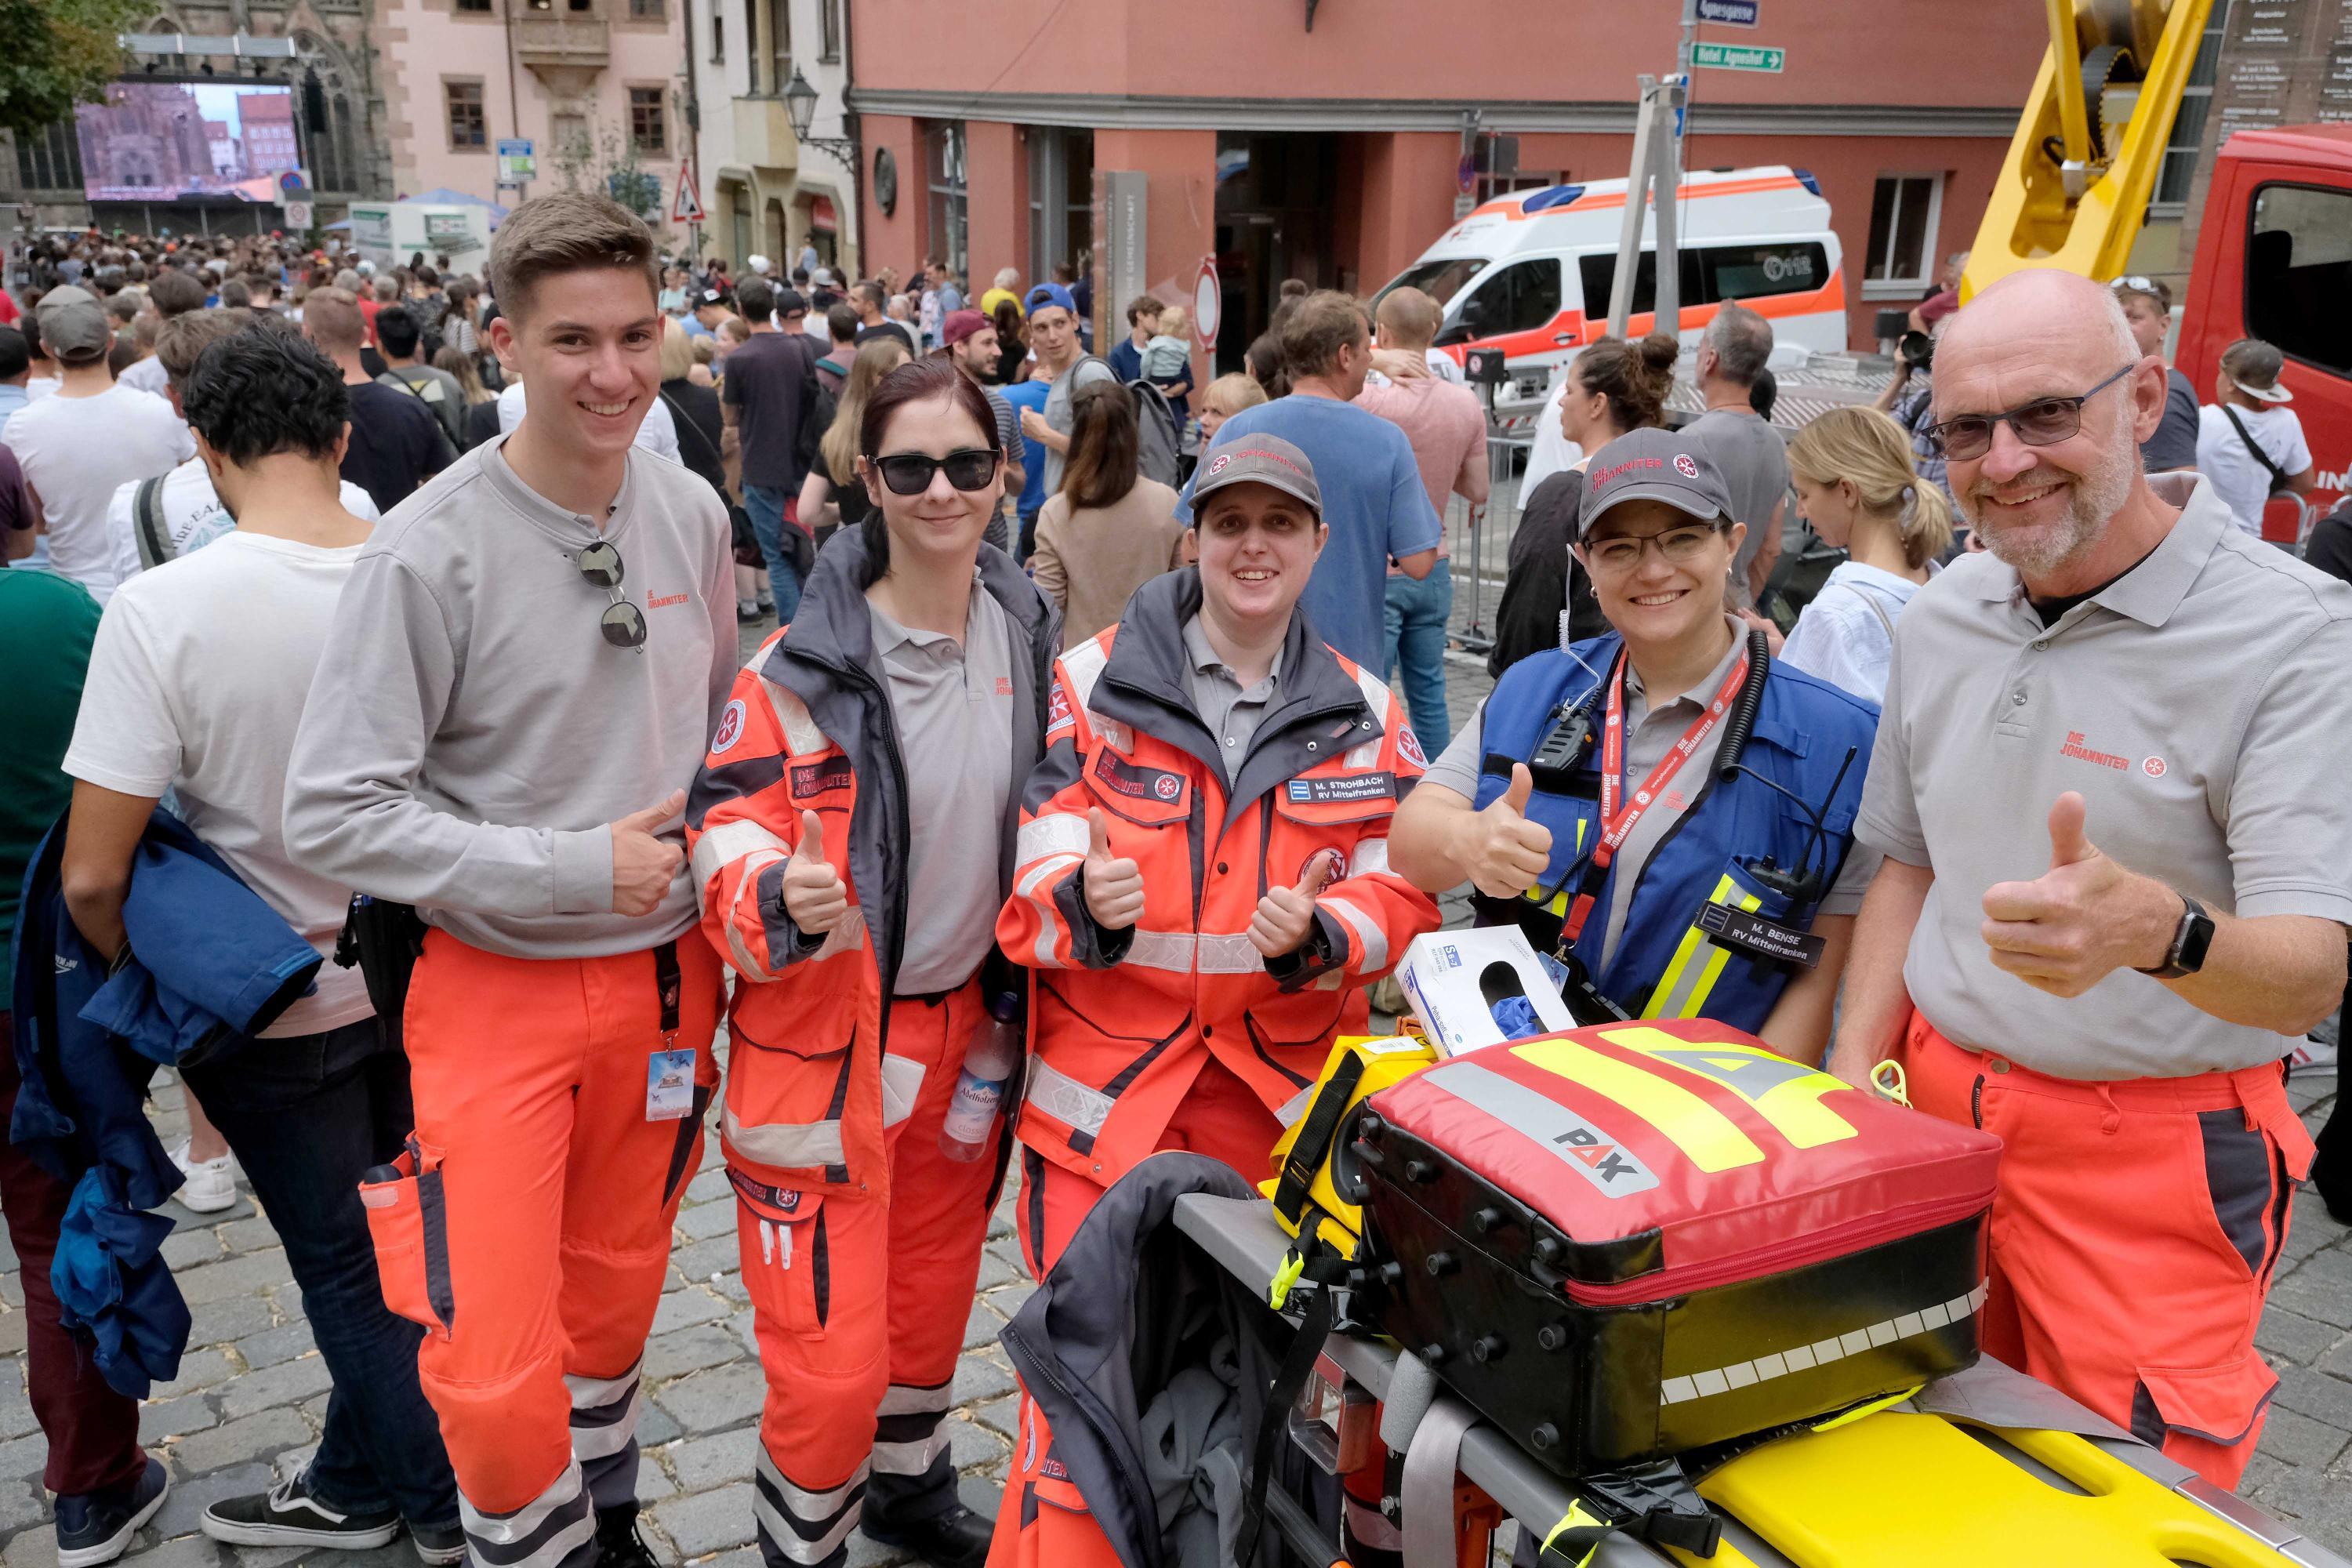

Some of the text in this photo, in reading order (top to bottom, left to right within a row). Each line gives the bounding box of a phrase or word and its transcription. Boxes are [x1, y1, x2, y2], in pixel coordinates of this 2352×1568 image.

[1698, 47, 1765, 68] Hotel Agneshof
[1677, 738, 1690, 750] DIE
[1682, 719, 1713, 757] JOHANNITER
[2067, 730, 2085, 746] DIE
[2060, 743, 2130, 771] JOHANNITER
[795, 768, 815, 782] DIE
[1315, 776, 1384, 791] M. STROHBACH
[1318, 787, 1386, 800] RV Mittelfranken
[1602, 773, 1611, 817] JOHANNITER
[1604, 832, 1615, 844] DIE
[1610, 810, 1640, 849] JOHANNITER
[1731, 929, 1807, 960] RV Mittelfranken
[1751, 923, 1802, 945] M. BENSE
[1552, 1127, 1639, 1183] PAX
